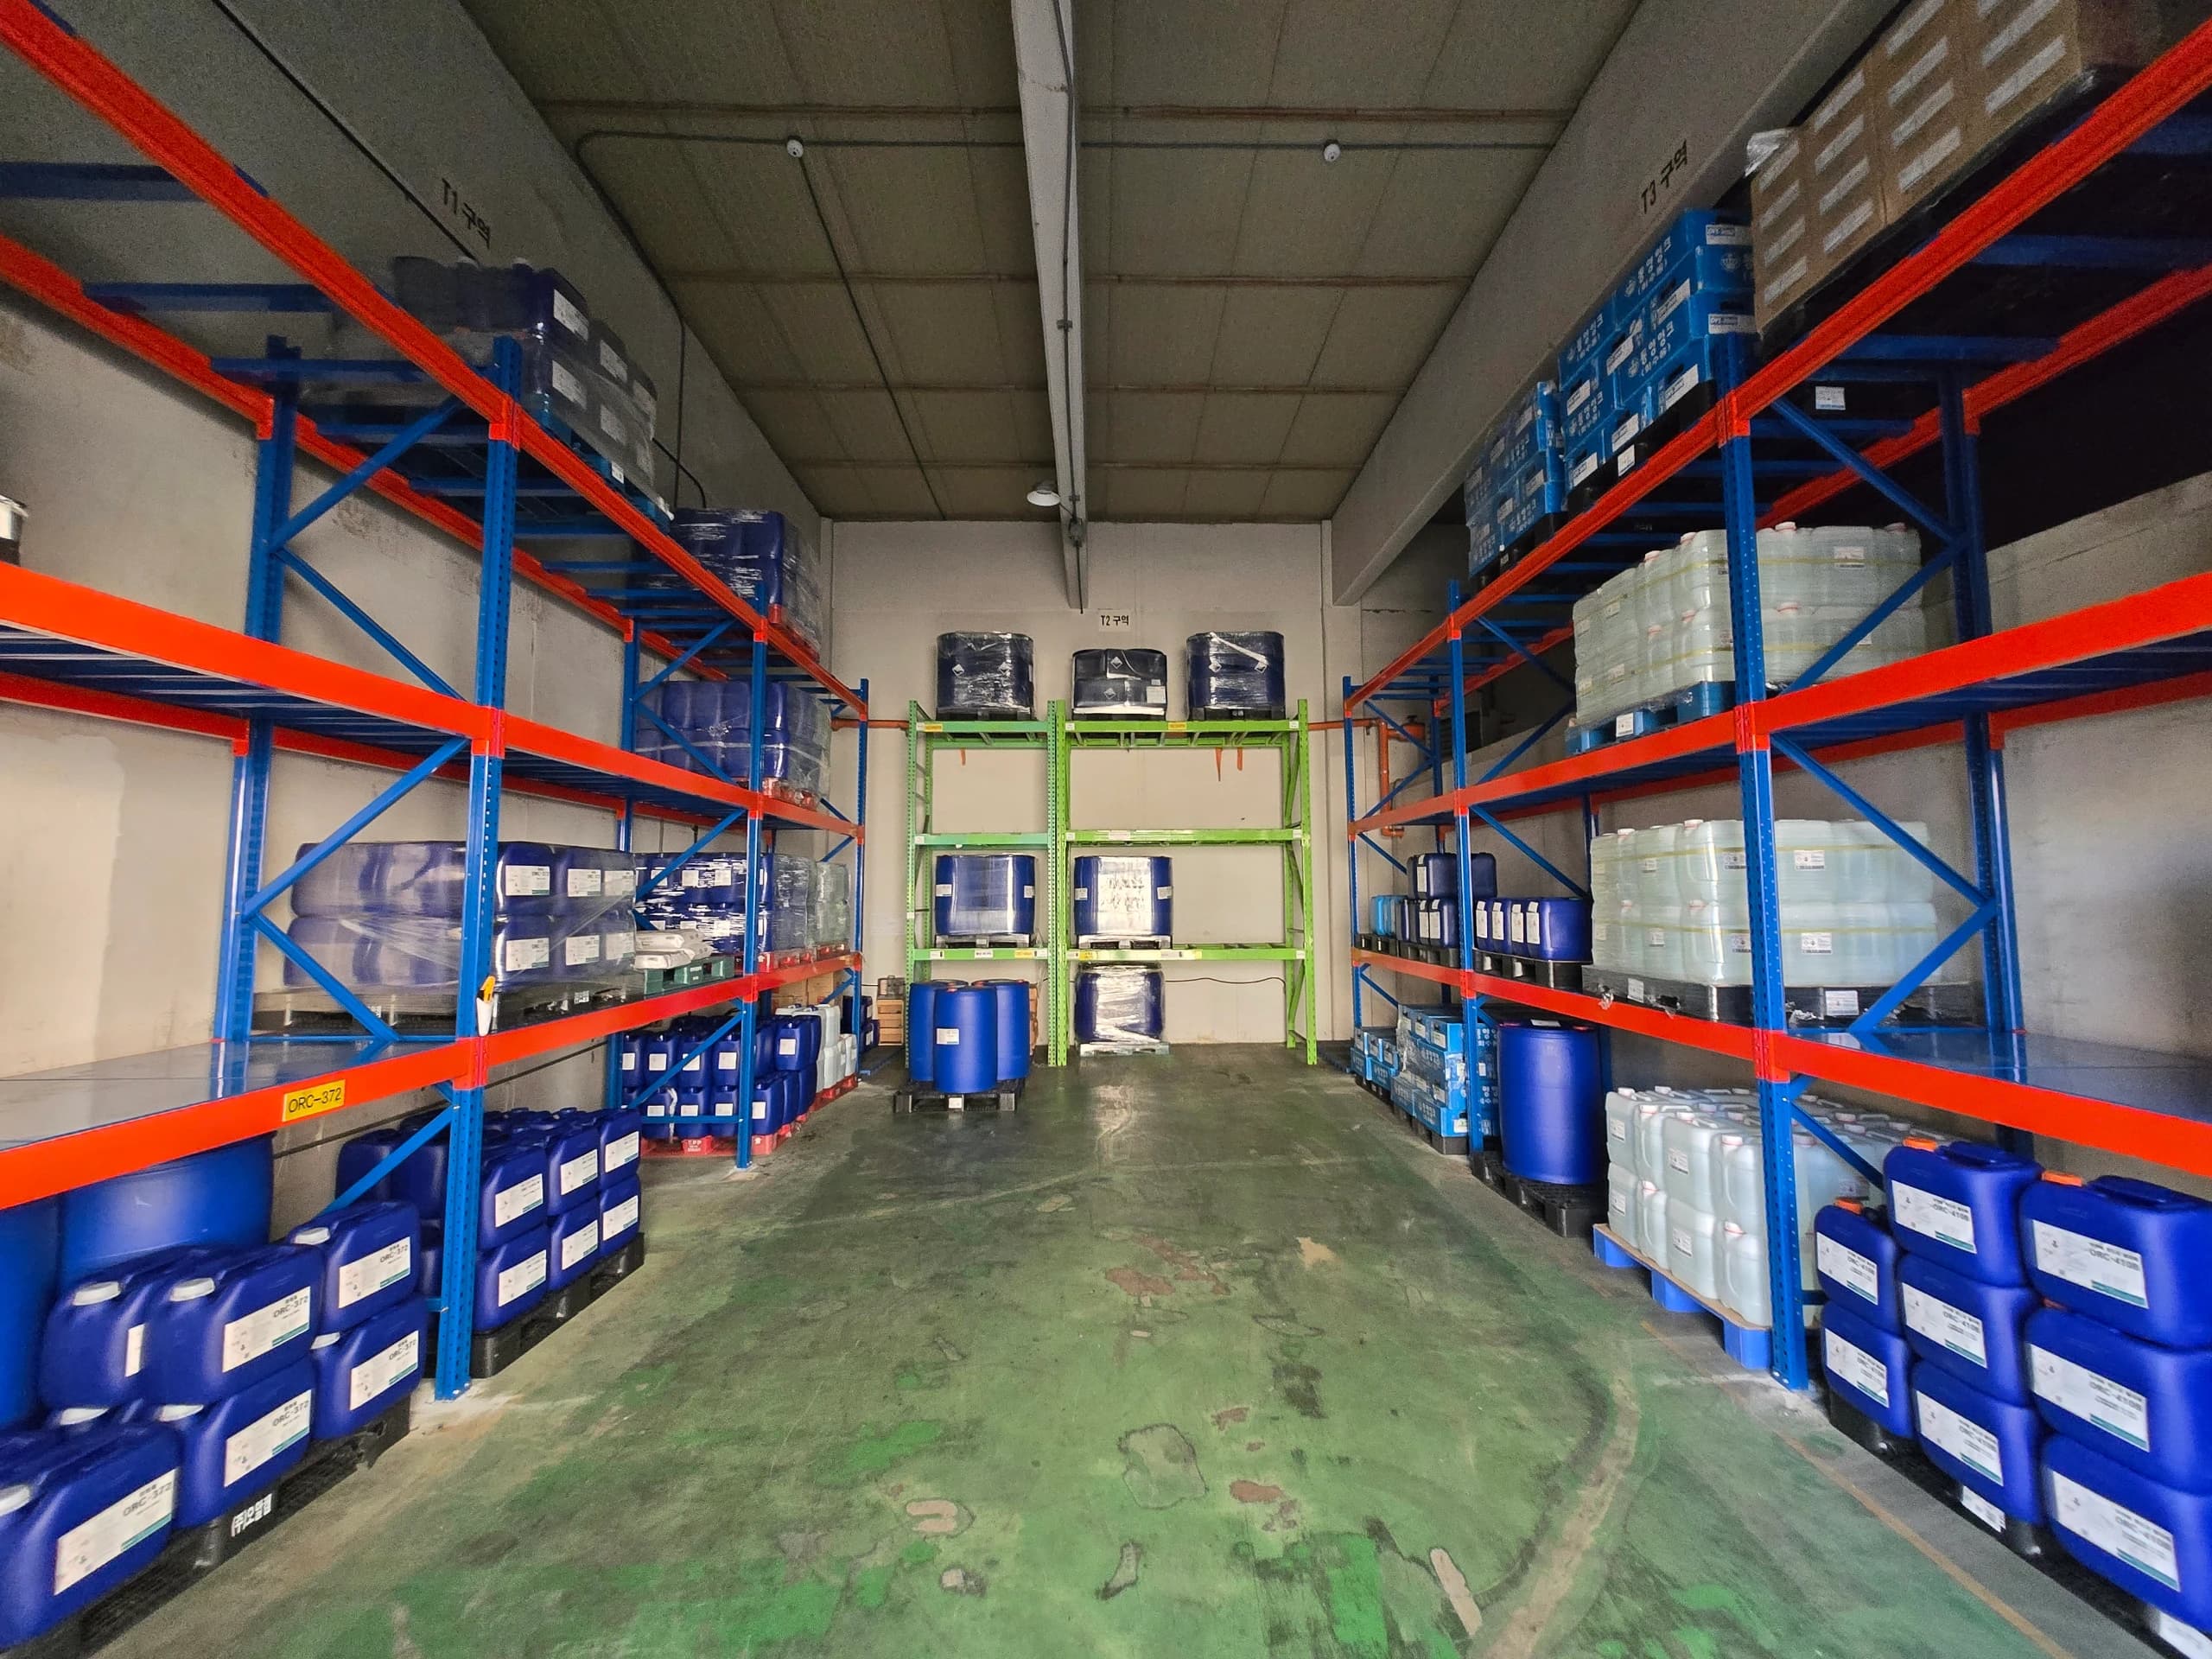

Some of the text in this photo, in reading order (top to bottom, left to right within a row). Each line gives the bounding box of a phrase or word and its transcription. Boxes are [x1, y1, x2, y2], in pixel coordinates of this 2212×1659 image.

[1641, 138, 1688, 215] T3 구역
[442, 177, 491, 250] T1 구역
[1101, 614, 1129, 626] T2 구역
[288, 1087, 342, 1113] ORC-372
[273, 1295, 308, 1318] ORC-372
[389, 1339, 416, 1360] ORC-372
[271, 1400, 309, 1427] ORC-372
[123, 1482, 172, 1516] ORC-372
